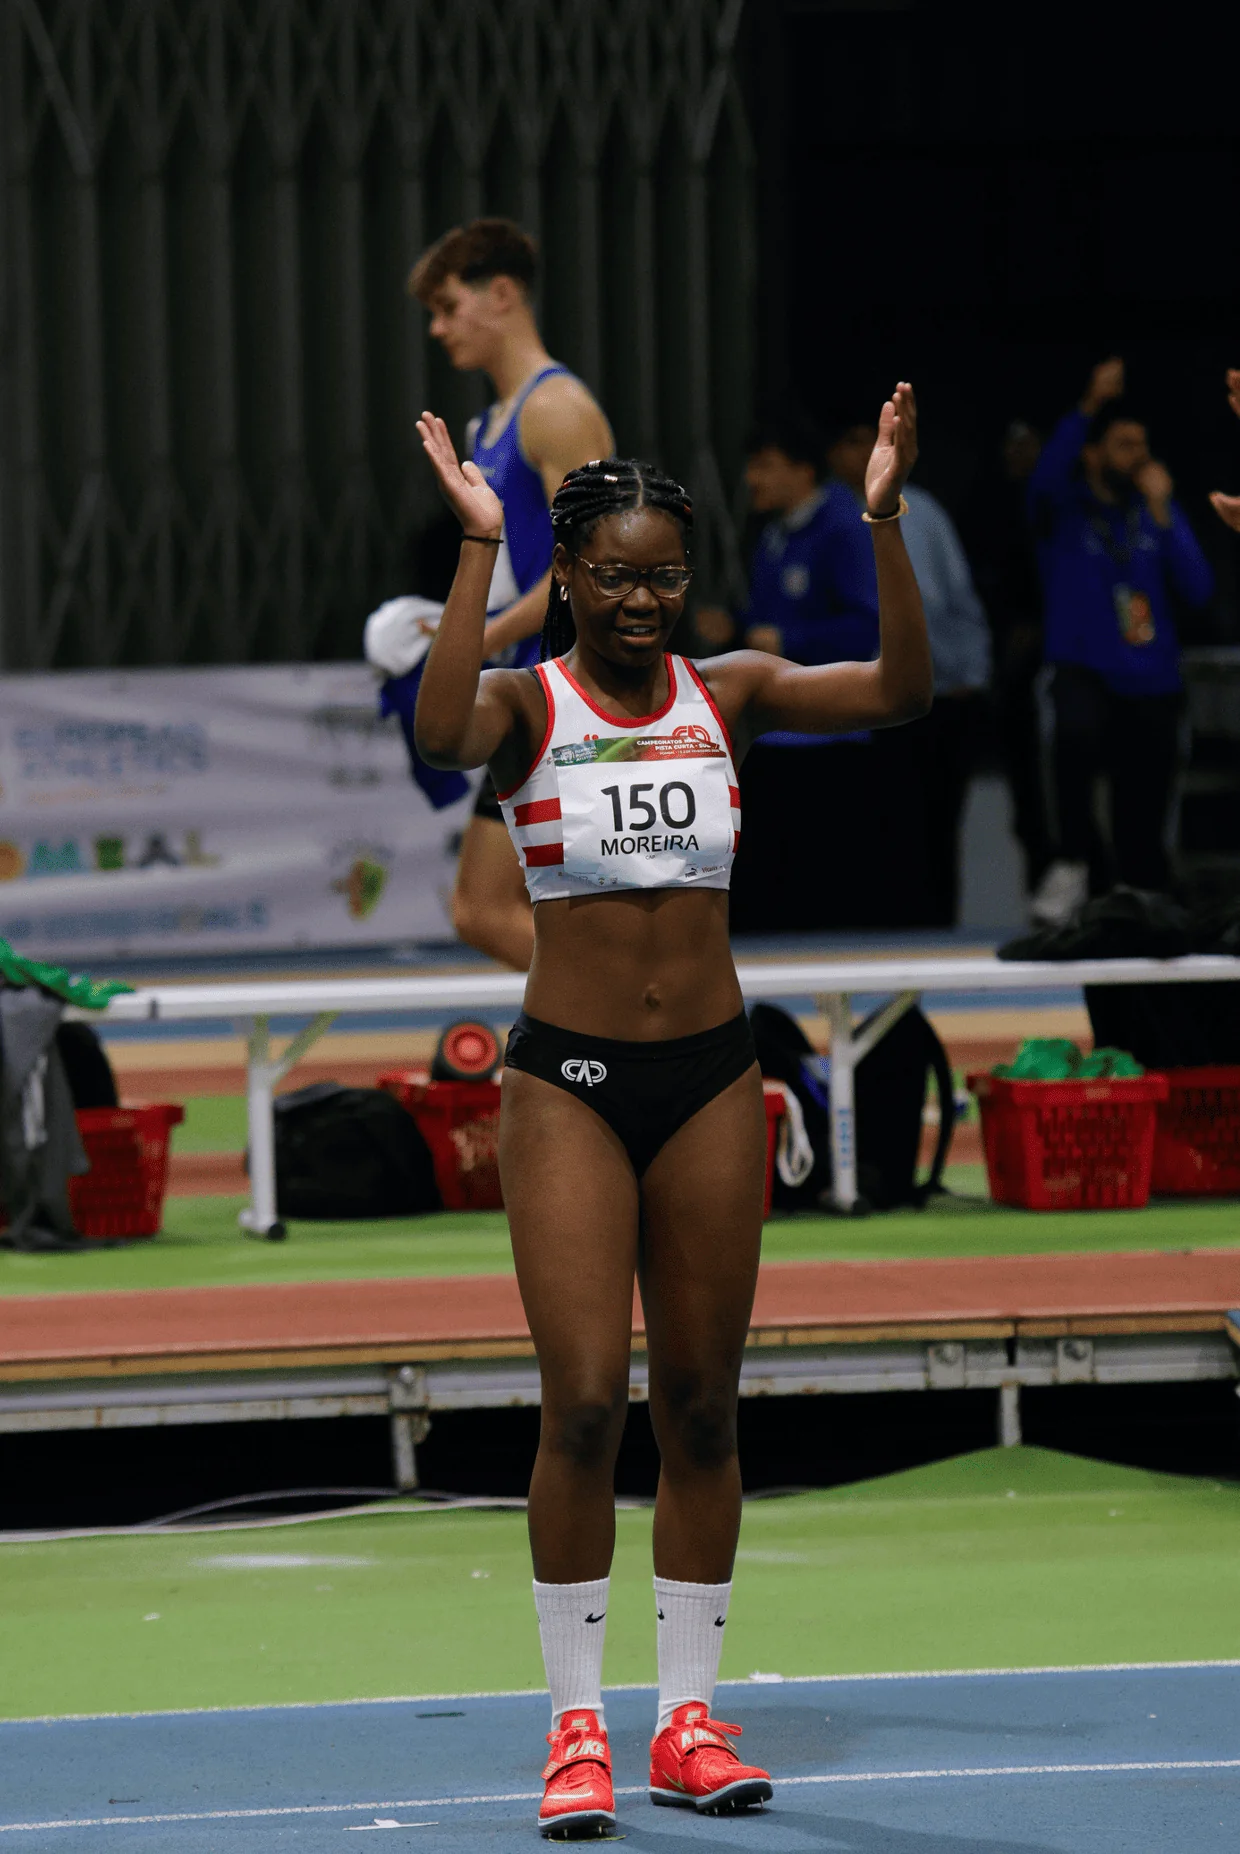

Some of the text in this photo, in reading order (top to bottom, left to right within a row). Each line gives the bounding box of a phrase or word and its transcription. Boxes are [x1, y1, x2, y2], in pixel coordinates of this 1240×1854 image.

[600, 781, 696, 832] 150
[601, 834, 699, 856] MOREIRA
[564, 1740, 605, 1760] NIKE
